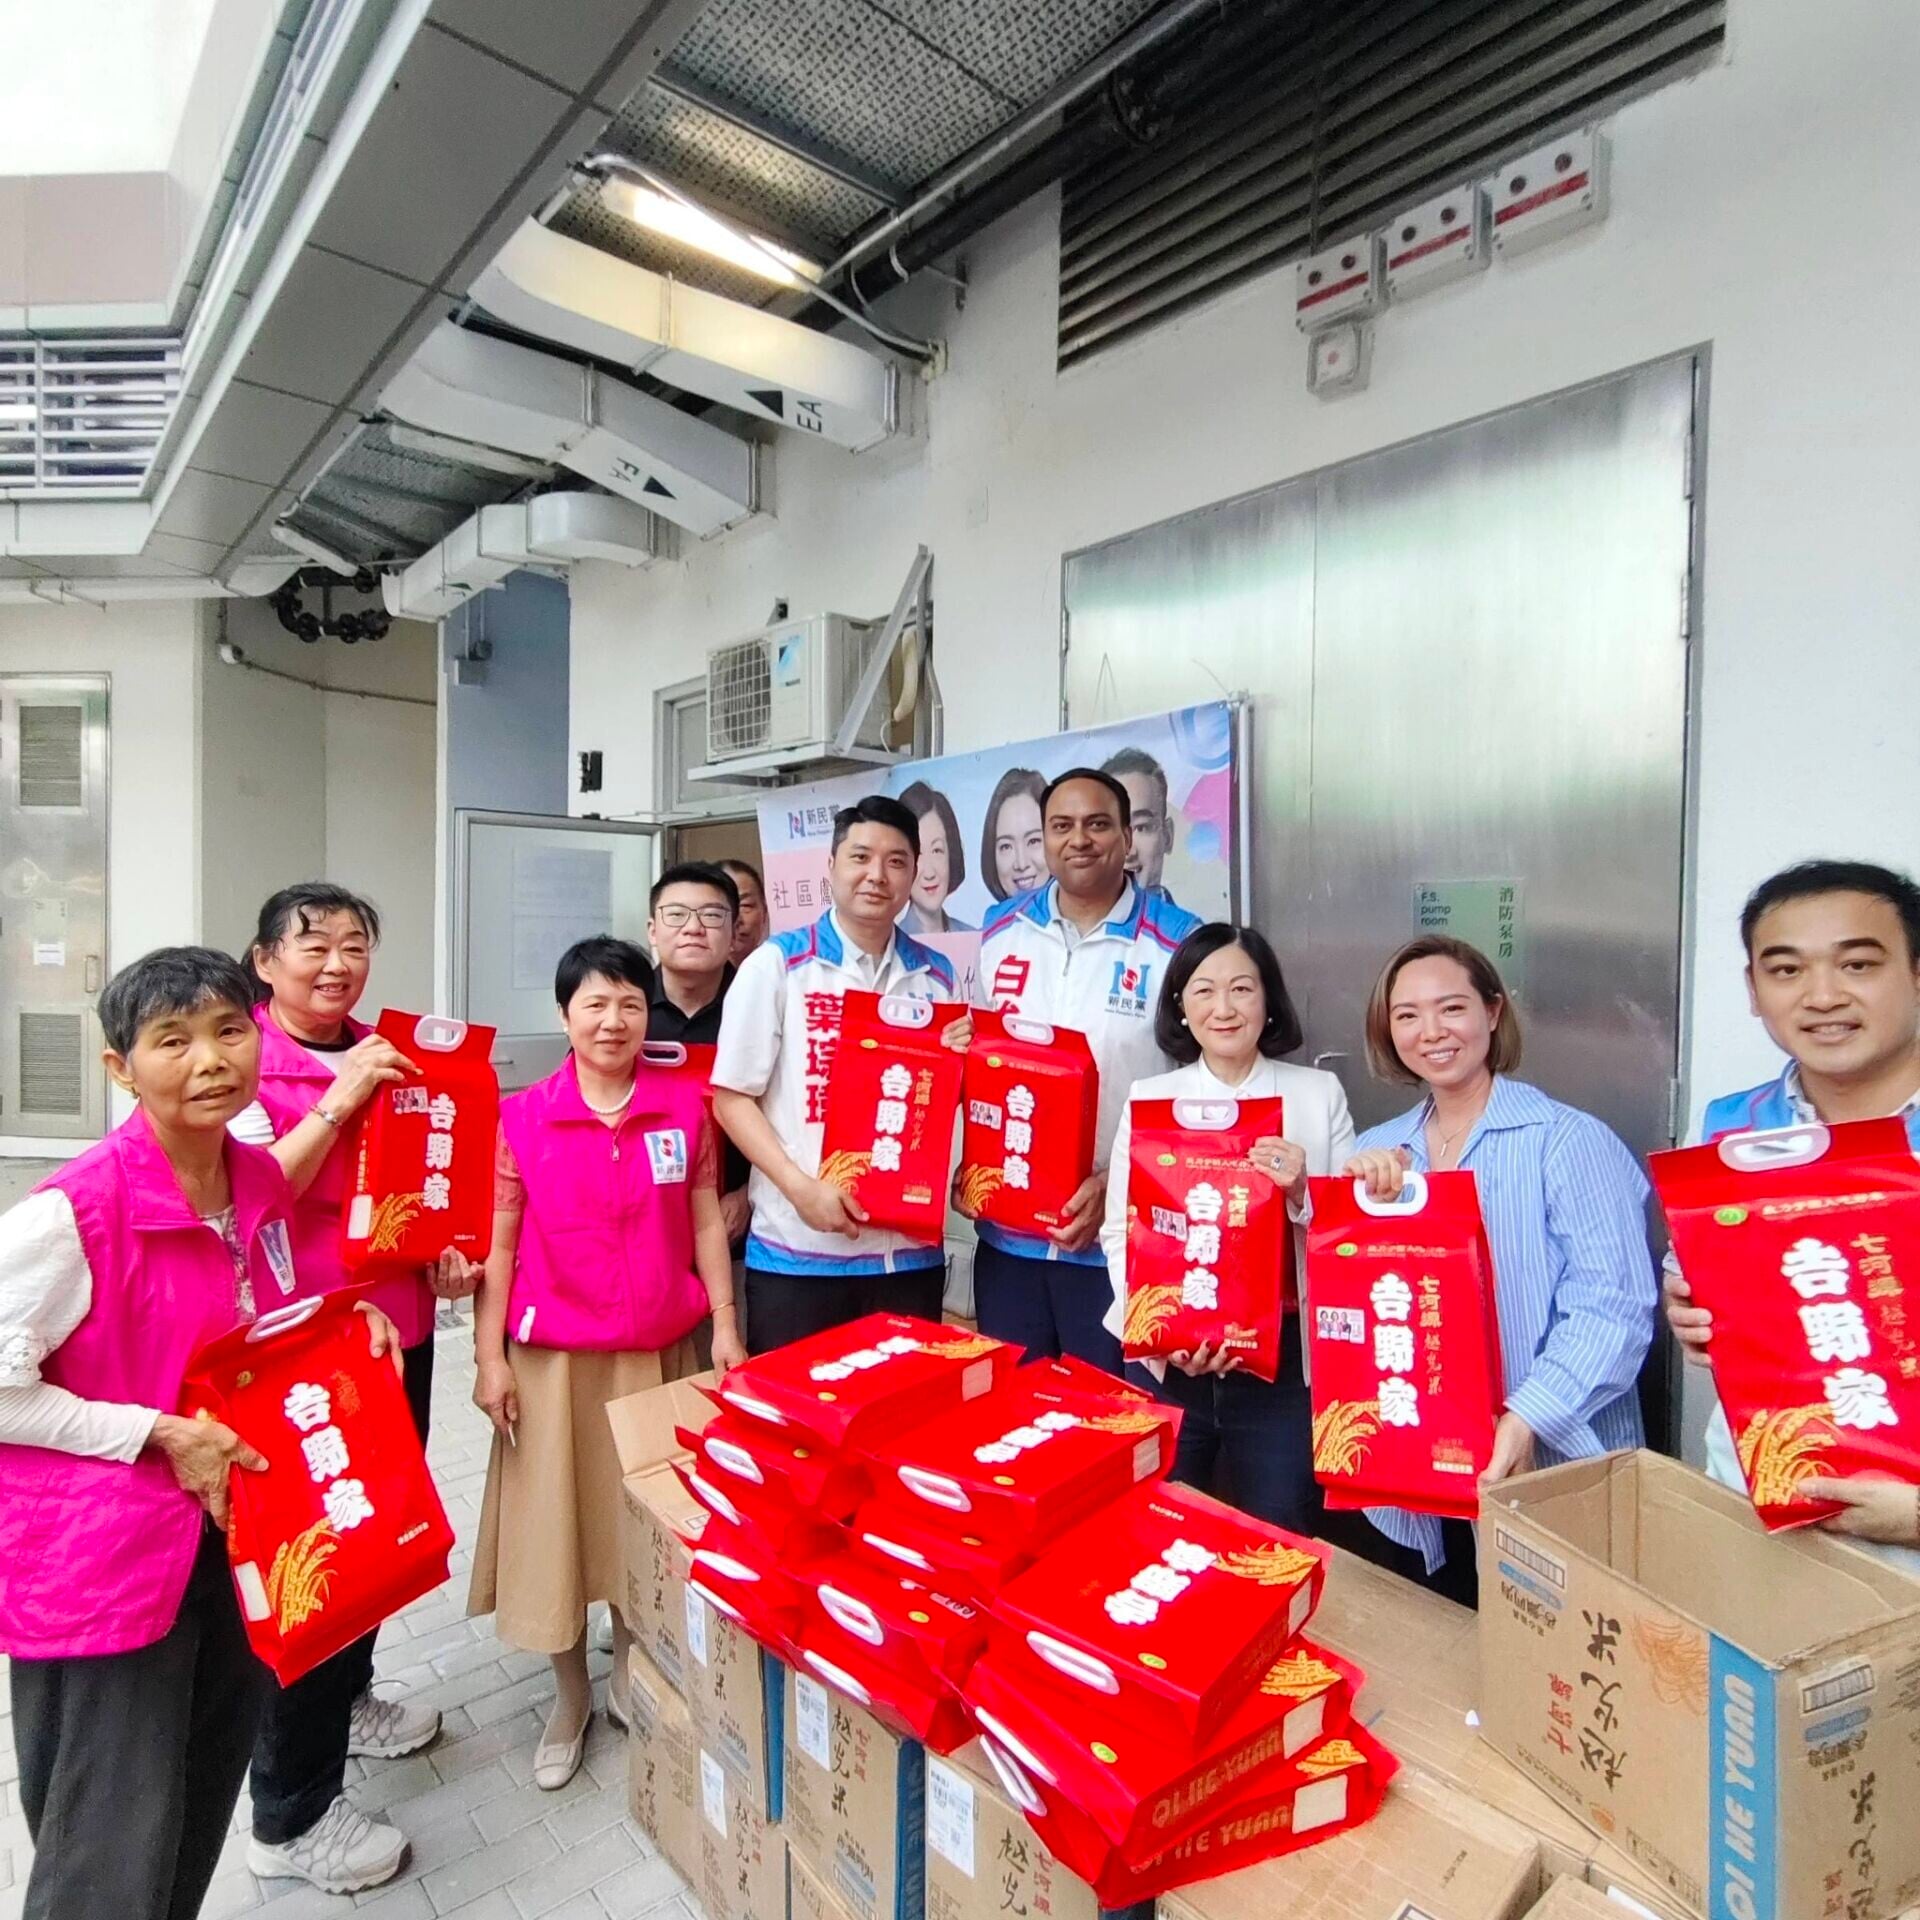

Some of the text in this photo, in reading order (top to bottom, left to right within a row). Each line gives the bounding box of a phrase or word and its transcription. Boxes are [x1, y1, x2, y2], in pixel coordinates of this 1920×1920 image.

[797, 400, 822, 433] EA
[1421, 905, 1451, 915] pump
[1421, 917, 1448, 926] room
[1369, 1272, 1421, 1428] 吉野家
[1780, 1237, 1899, 1430] 吉野家
[284, 1382, 375, 1532] 吉野家
[1724, 1795, 1756, 1862] HE
